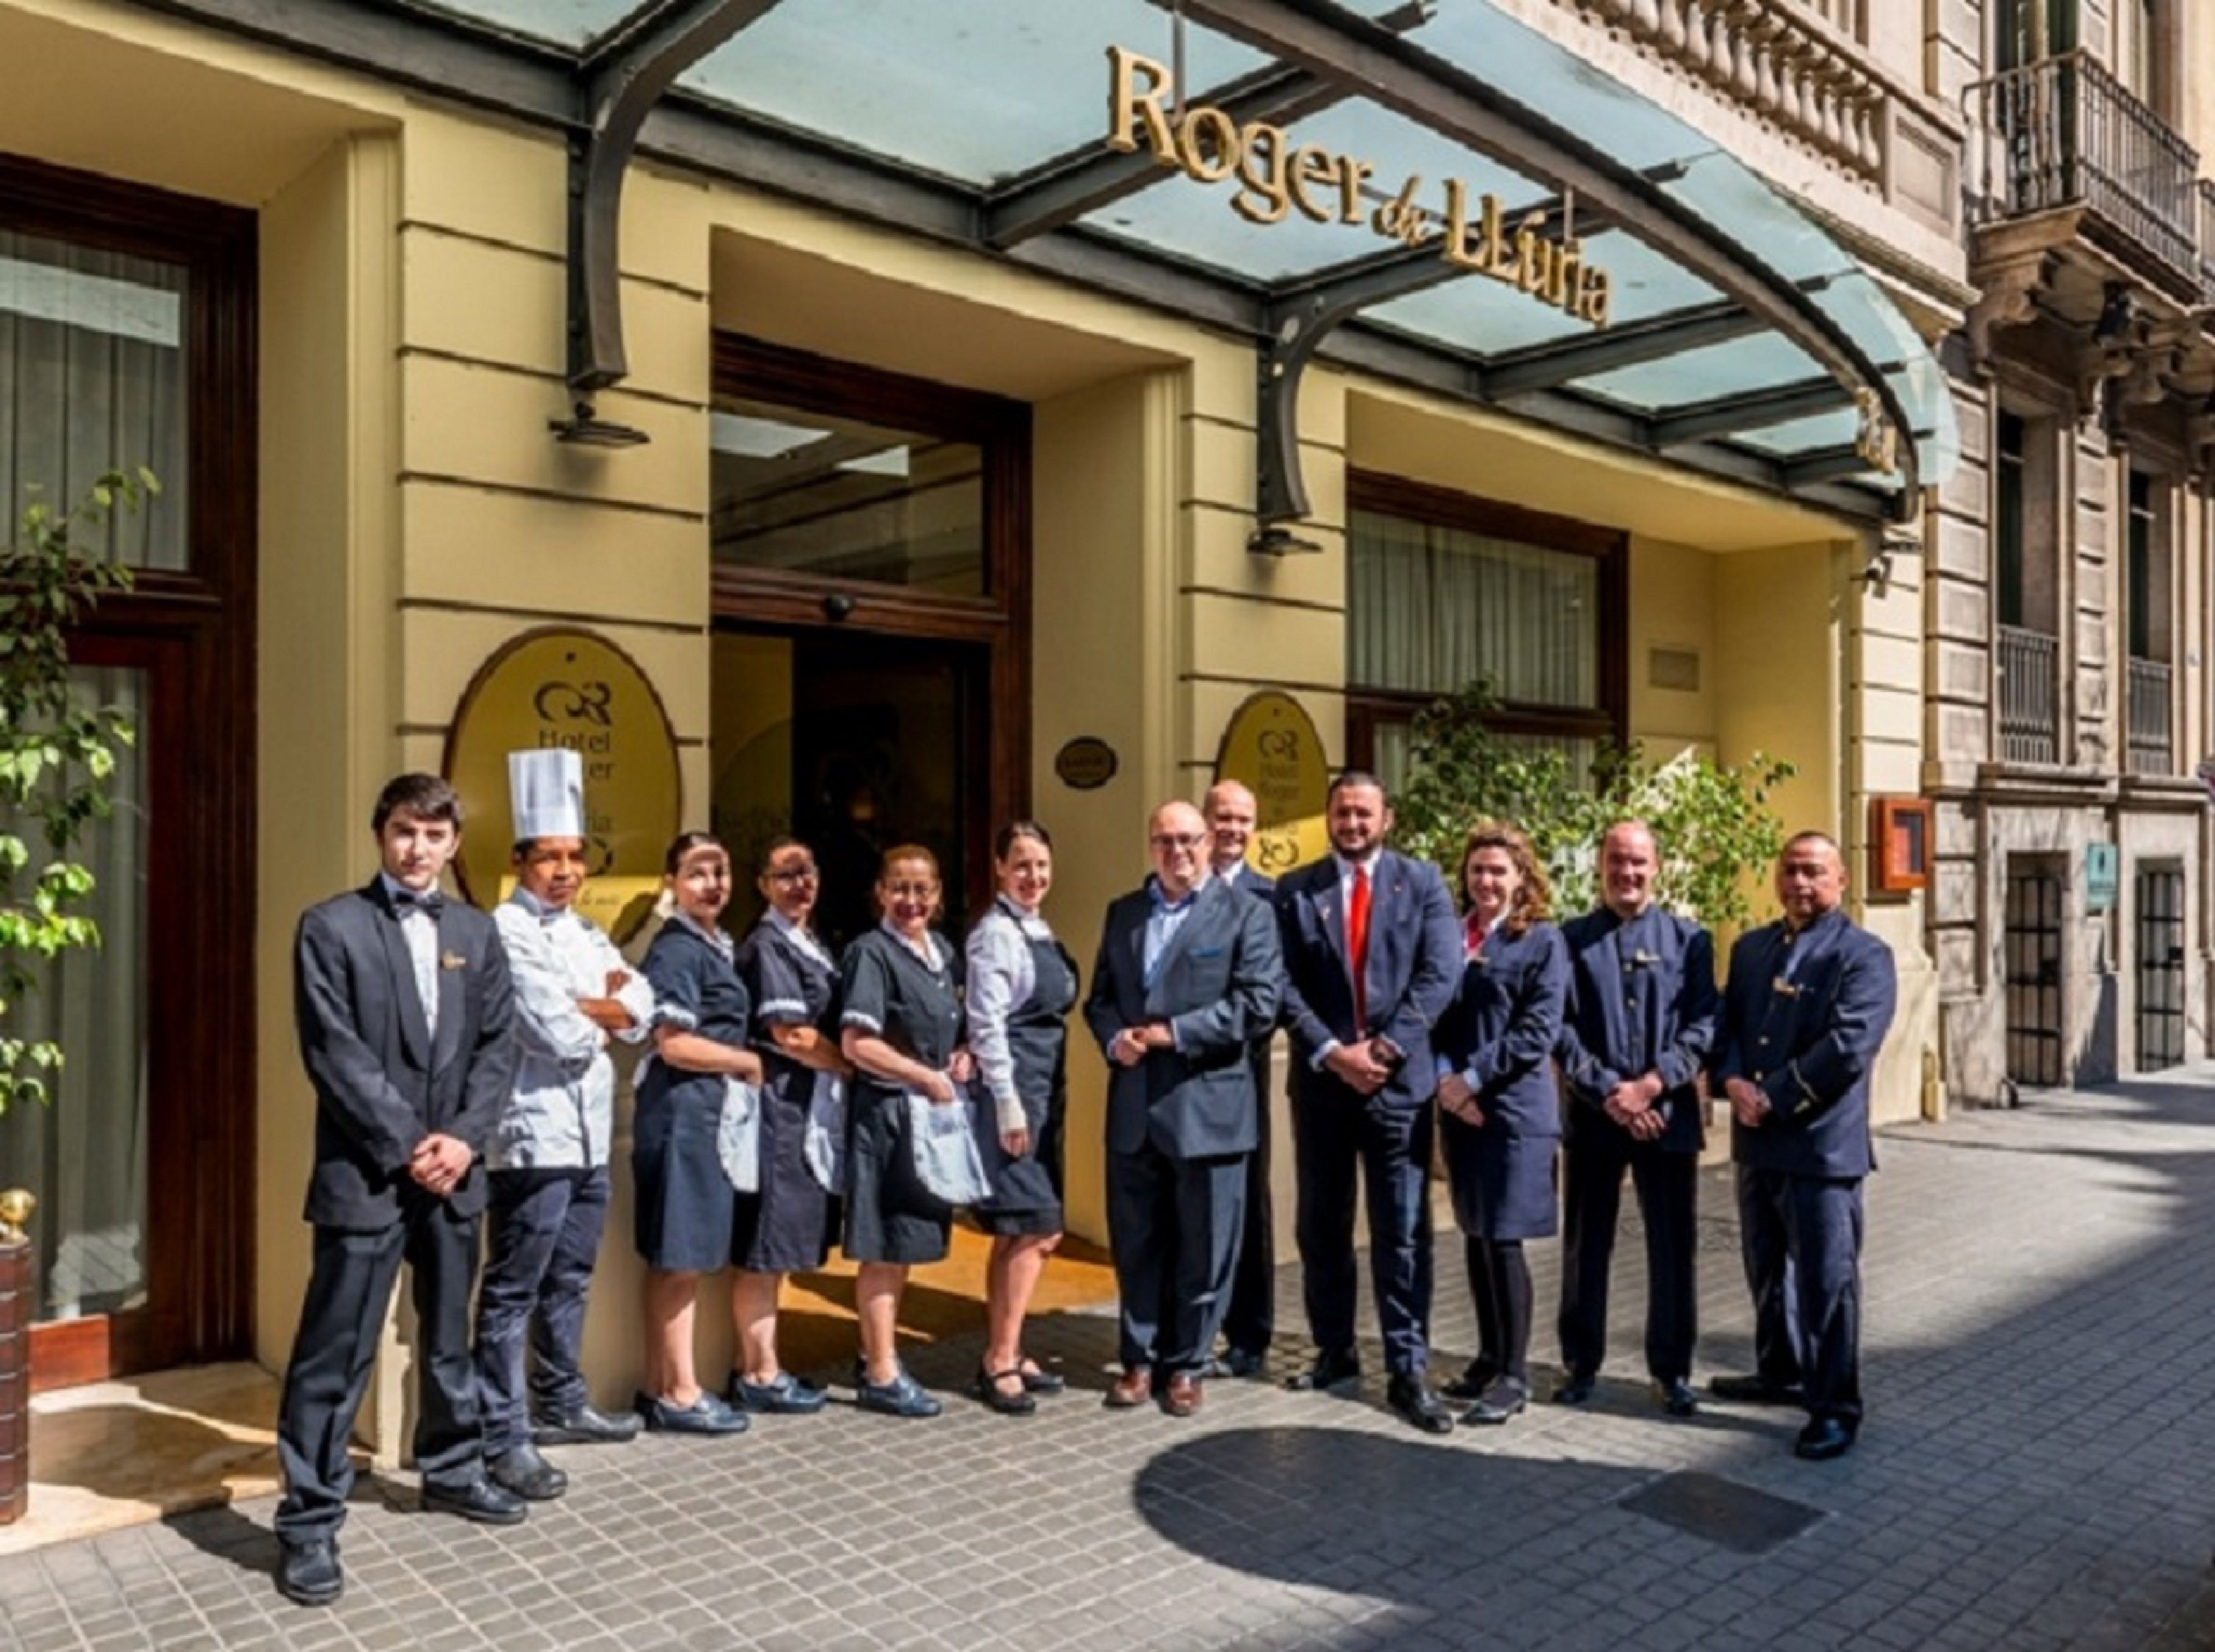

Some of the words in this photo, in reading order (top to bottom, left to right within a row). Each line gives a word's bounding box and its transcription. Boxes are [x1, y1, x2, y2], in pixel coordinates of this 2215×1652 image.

[1106, 45, 1372, 225] Roger
[1374, 175, 1429, 247] de
[539, 730, 611, 754] Hotel
